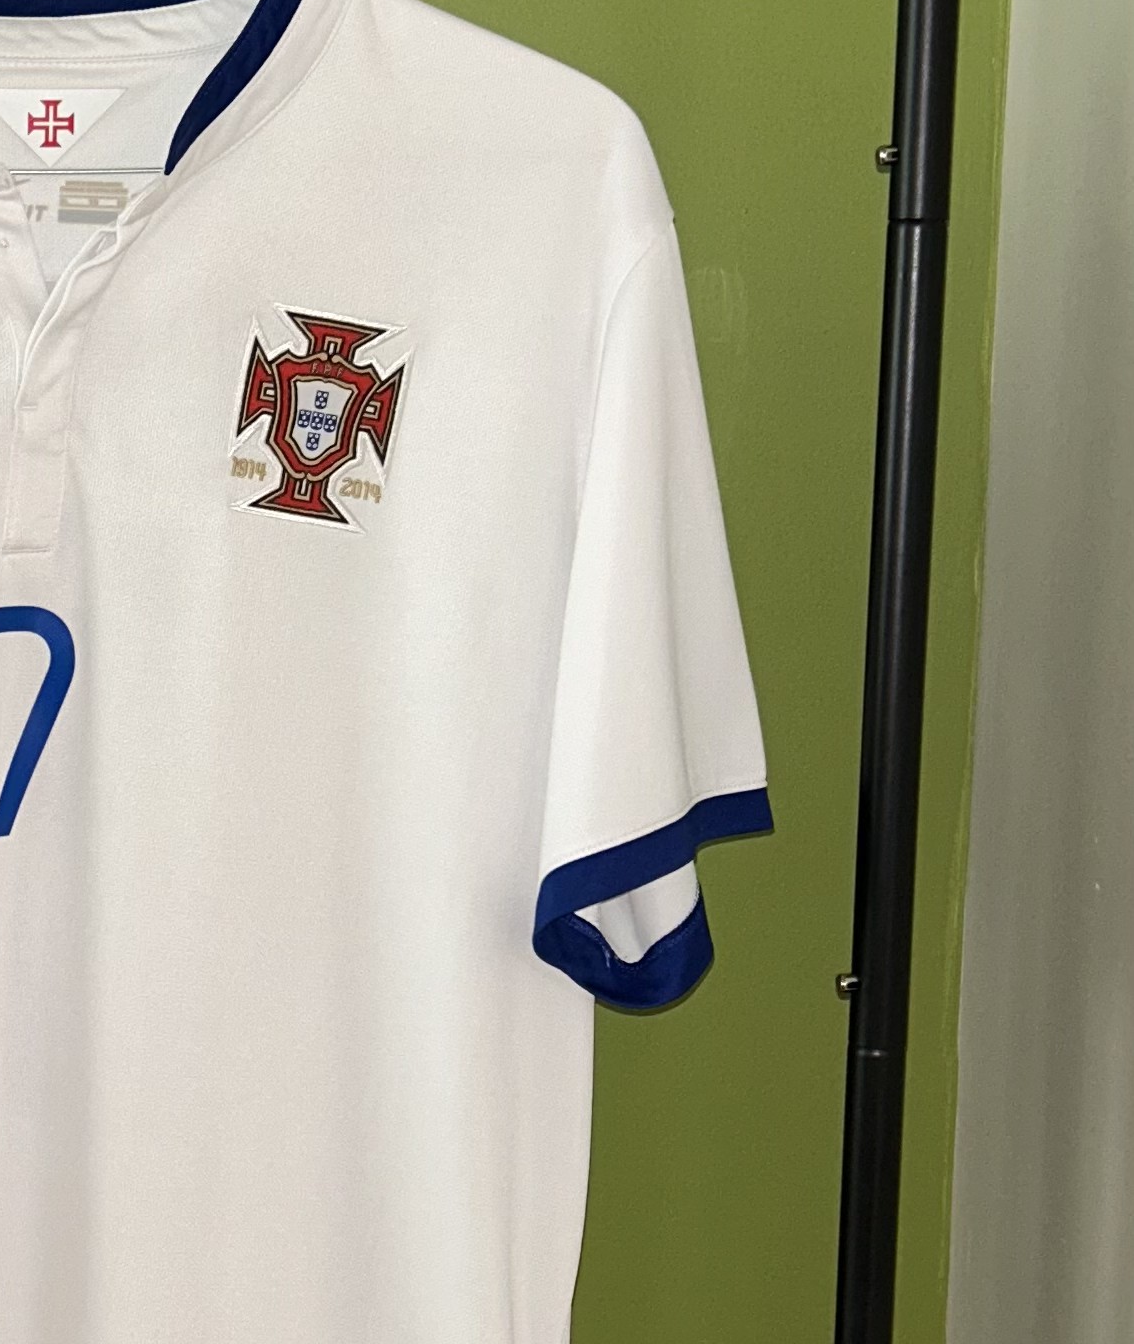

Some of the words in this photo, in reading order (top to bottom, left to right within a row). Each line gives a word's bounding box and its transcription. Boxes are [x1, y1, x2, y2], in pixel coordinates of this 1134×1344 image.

[25, 204, 49, 223] IT
[230, 456, 267, 482] 1914
[338, 476, 383, 504] 2014
